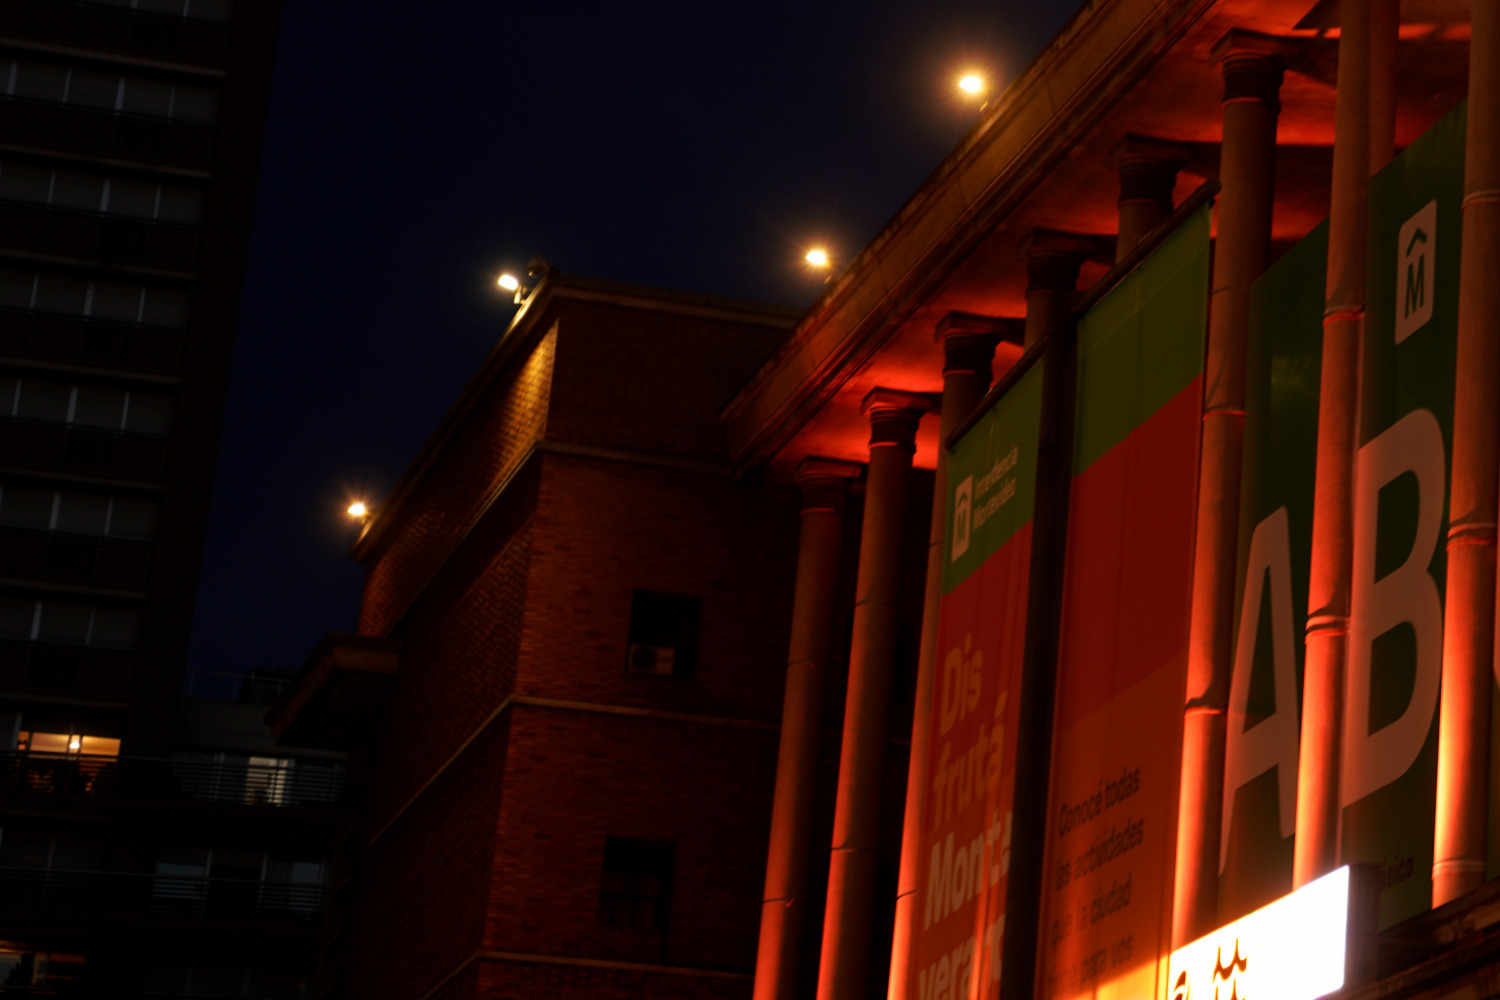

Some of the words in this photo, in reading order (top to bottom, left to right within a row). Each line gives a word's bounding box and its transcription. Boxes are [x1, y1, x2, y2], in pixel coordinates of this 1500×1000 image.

[939, 633, 983, 736] Dis
[934, 690, 1007, 832] frutá
[1059, 778, 1103, 838] Conocé
[1105, 766, 1141, 810] todas
[1074, 815, 1145, 880] actividades
[1379, 853, 1414, 891] ásico
[1090, 871, 1132, 925] ciudad
[1110, 935, 1133, 968] vos
